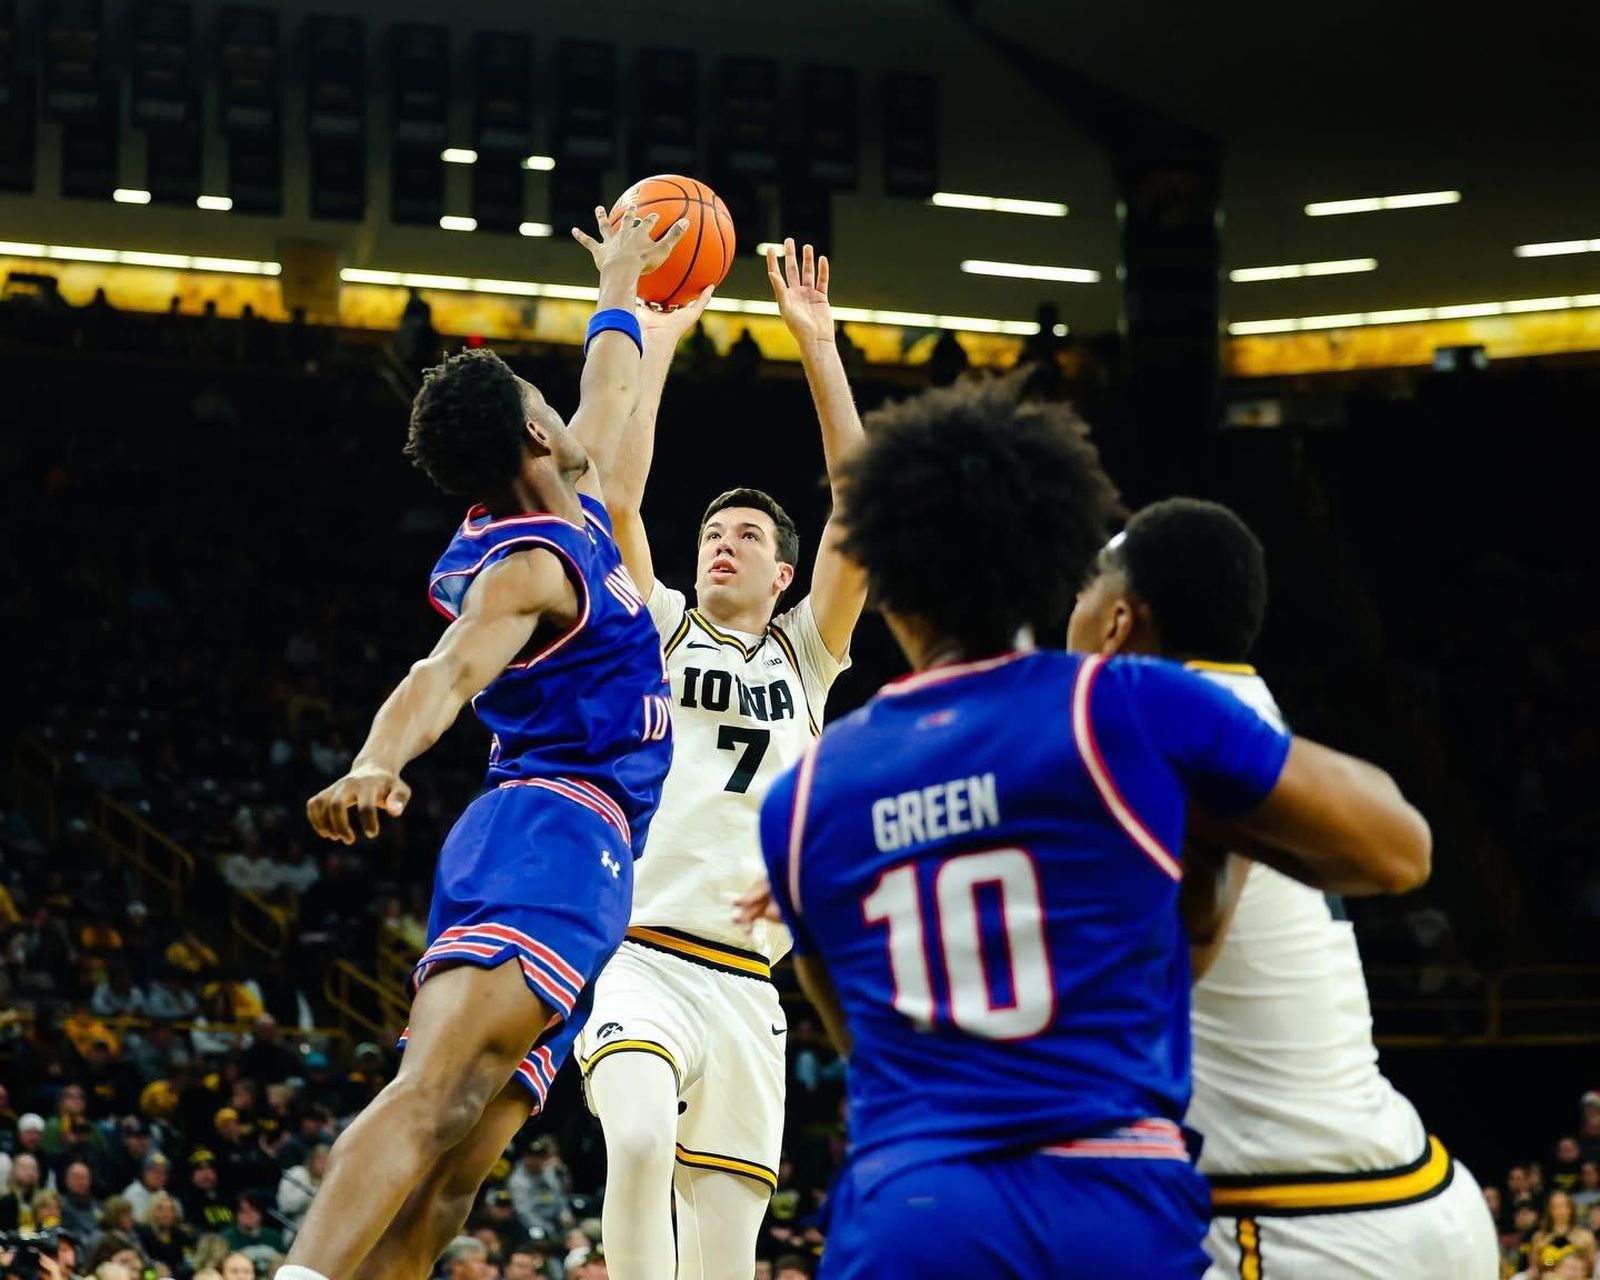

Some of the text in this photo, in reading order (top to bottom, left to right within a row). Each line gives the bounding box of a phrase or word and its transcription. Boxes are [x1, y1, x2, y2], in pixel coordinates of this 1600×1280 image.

[681, 666, 794, 722] IOWA
[716, 724, 771, 794] 7
[871, 772, 1000, 853] GREEN
[862, 846, 1057, 1043] 10
